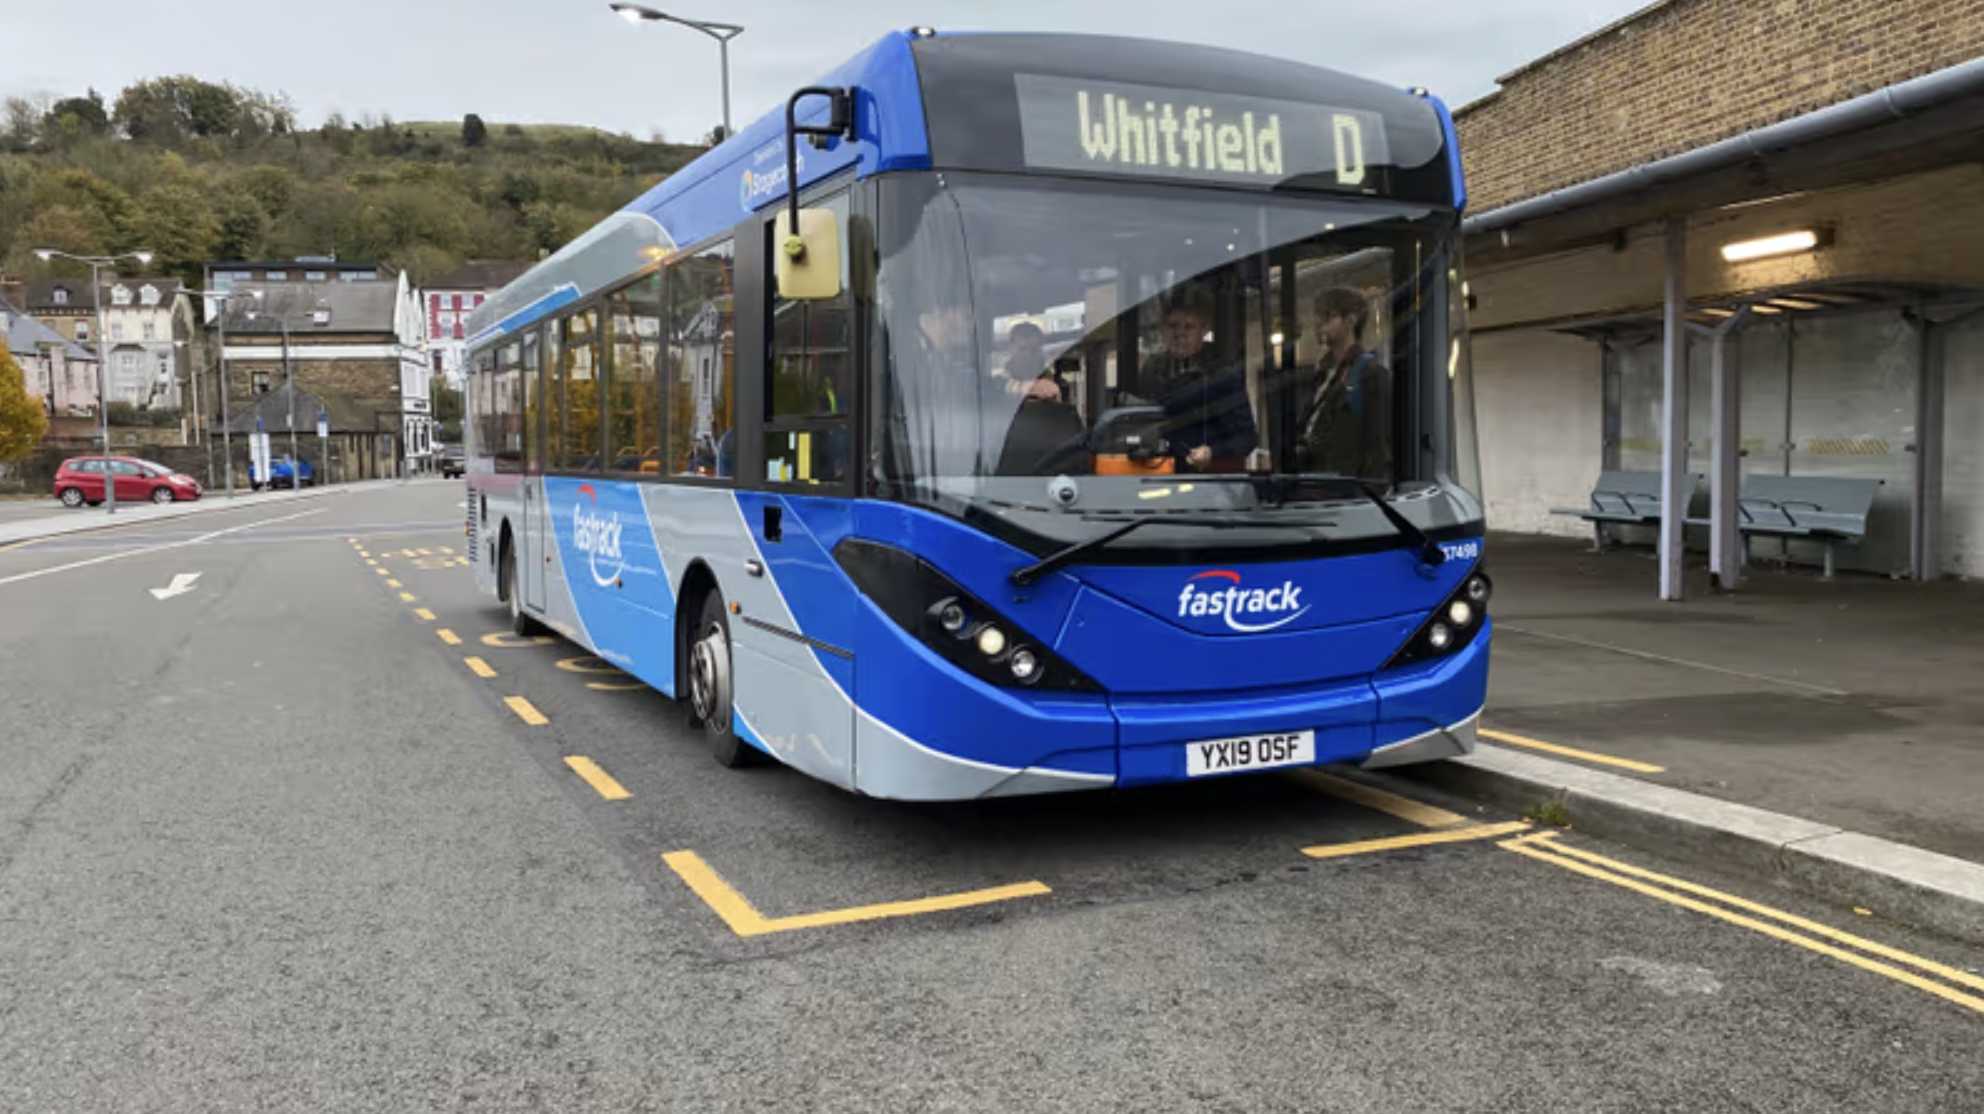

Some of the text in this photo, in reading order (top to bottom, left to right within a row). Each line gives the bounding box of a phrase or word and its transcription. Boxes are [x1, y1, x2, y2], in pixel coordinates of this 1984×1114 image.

[1078, 91, 1365, 185] Whitfield D
[573, 502, 625, 586] fastrack
[1178, 580, 1308, 630] fastrack
[1201, 736, 1300, 769] YX19 OSF
